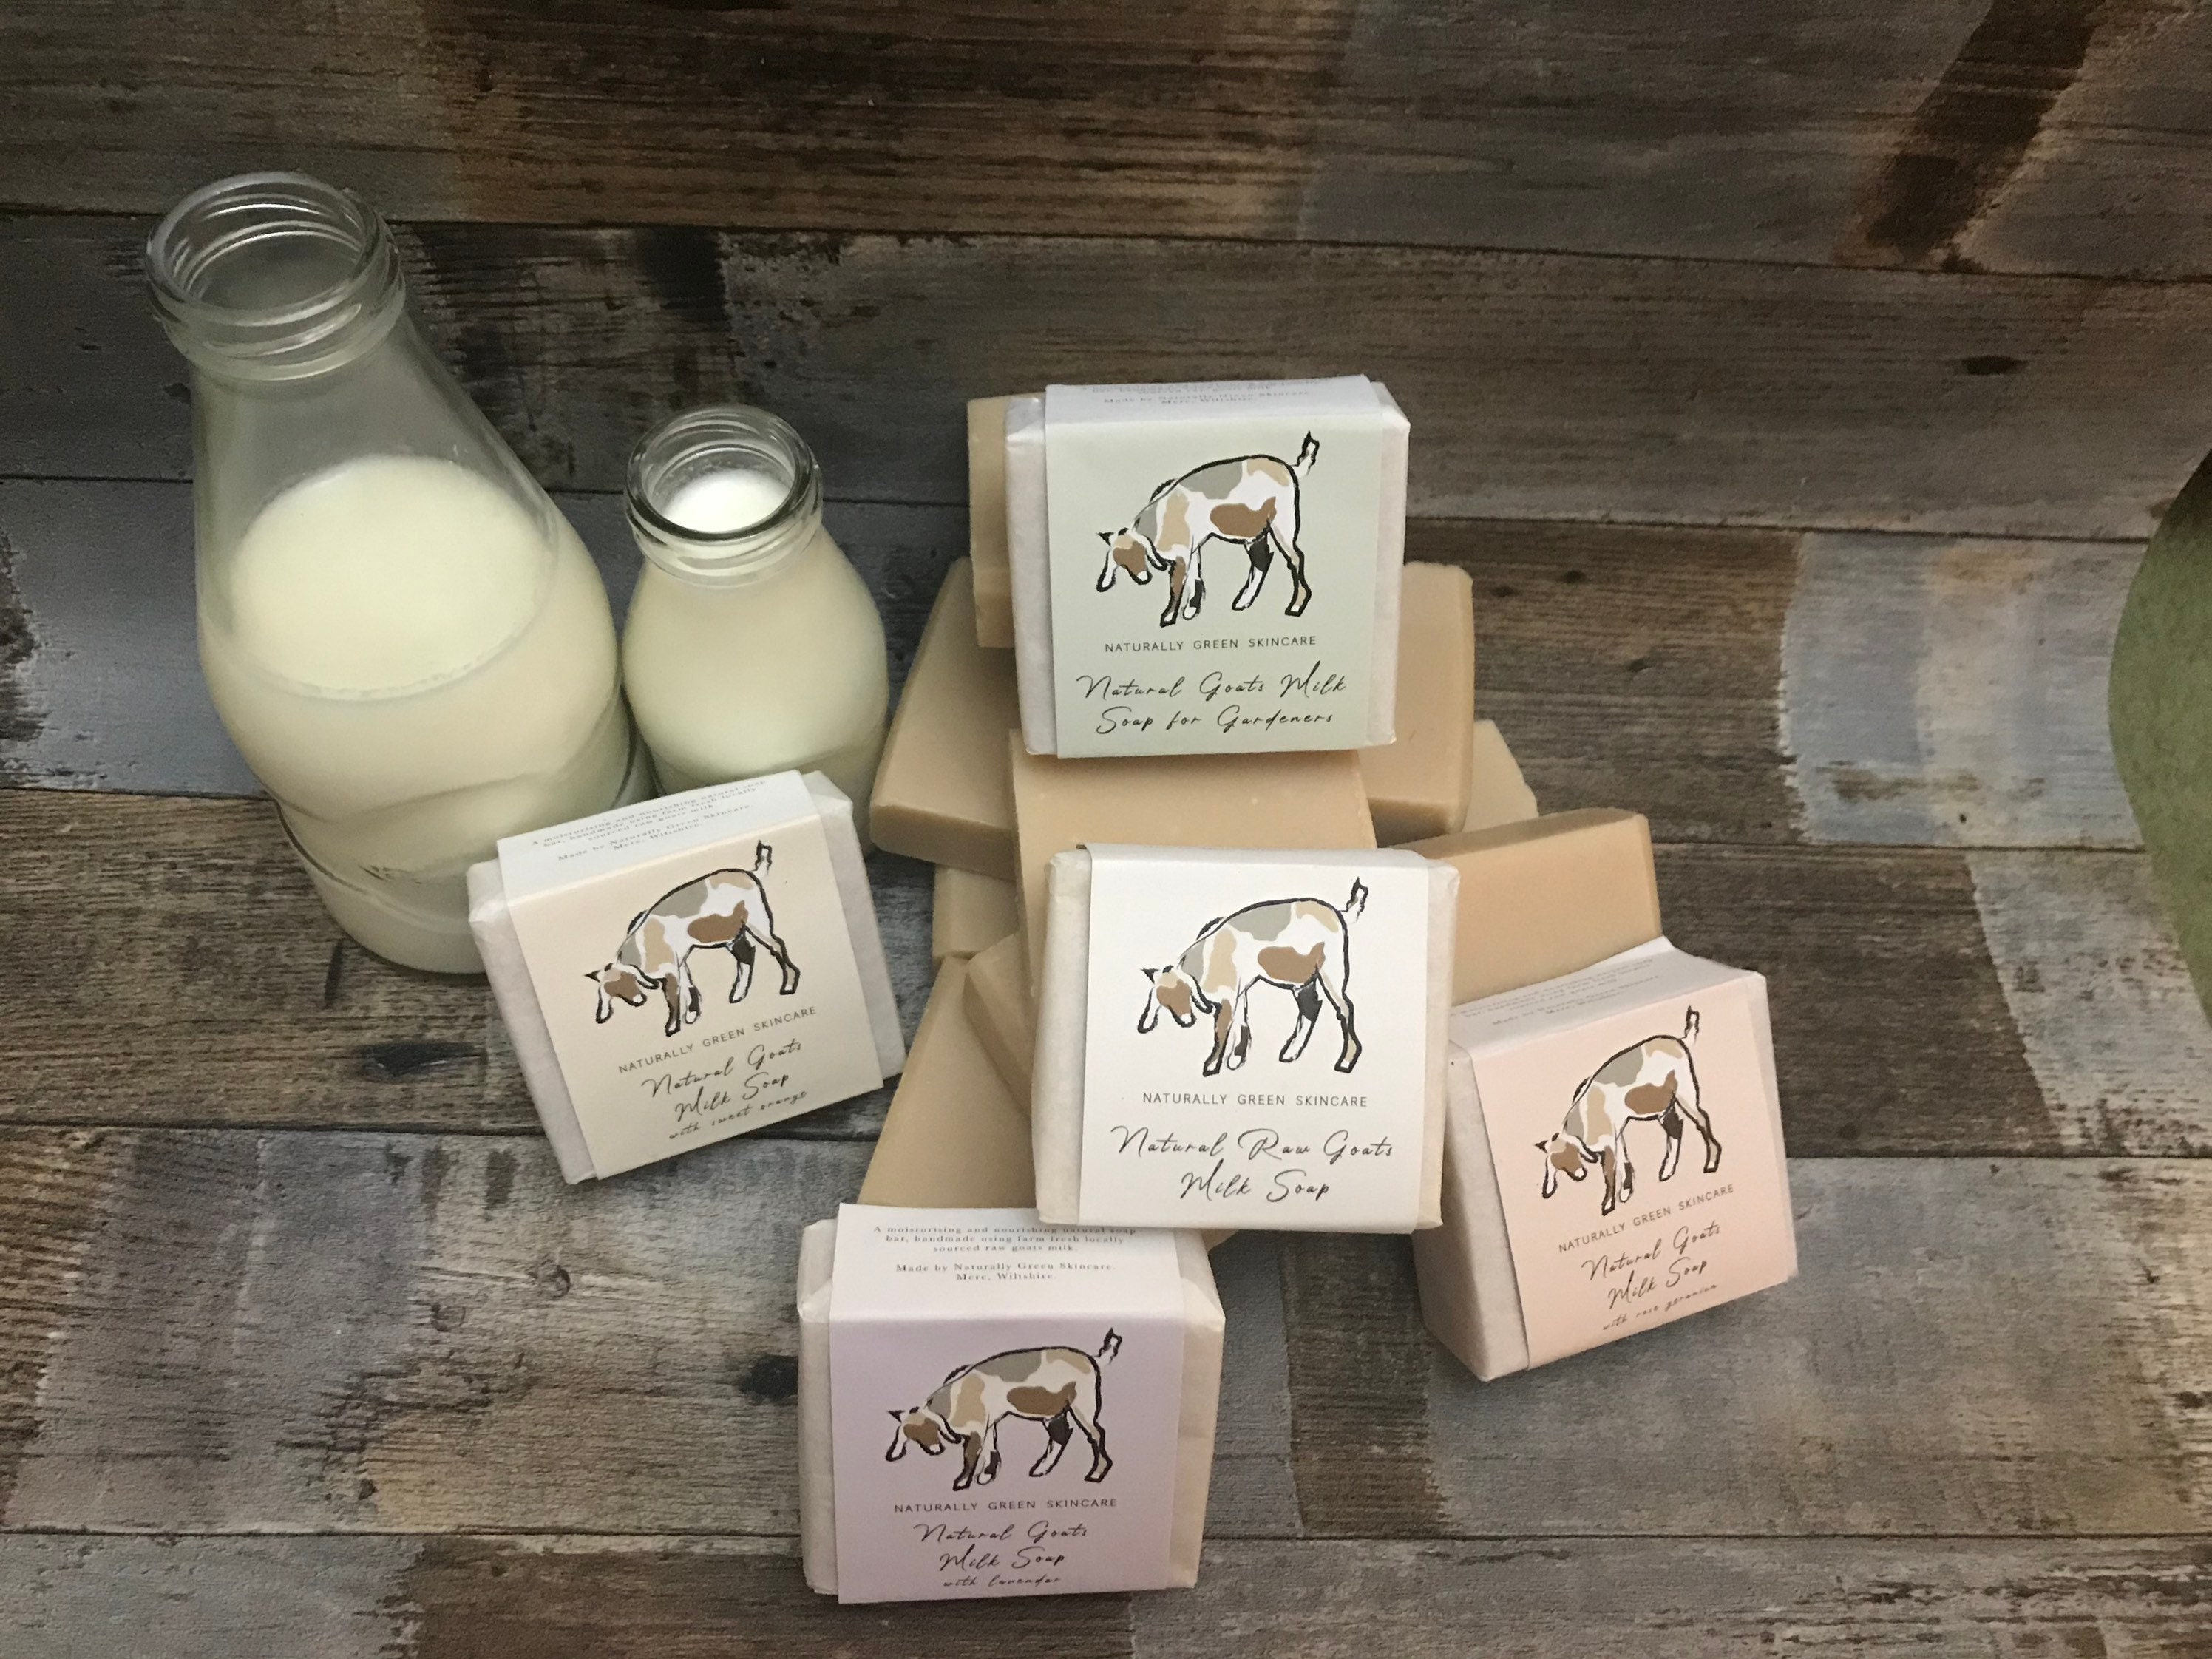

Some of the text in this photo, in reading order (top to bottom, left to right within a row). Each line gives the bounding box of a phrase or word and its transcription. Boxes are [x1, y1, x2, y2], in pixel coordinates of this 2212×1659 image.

[1105, 636, 1316, 652] NATURALLY GREEN SKINCARE
[1076, 660, 1347, 702] Natural Goats Milk
[1096, 705, 1332, 734] Soap for Gardeners
[619, 1006, 817, 1073] NATURALLY GREEN SKINCARE
[641, 1038, 802, 1098] Natural Goats
[675, 1071, 790, 1122] Milk Soap
[1143, 1093, 1367, 1107] NATURALLY GREEN SKINCARE
[669, 1090, 807, 1139] with sweet orange
[1110, 1126, 1392, 1165] Natural Raw Goats
[1180, 1158, 1329, 1202] Milk Soap
[887, 1226, 962, 1234] moisturising
[994, 1227, 1057, 1235] nourishing
[1558, 1184, 1734, 1253] NATURALLY GREEN SKINCARE
[1581, 1220, 1721, 1280] Natural Goats
[934, 1264, 948, 1272] by
[954, 1263, 1011, 1271] Naturally
[1607, 1256, 1707, 1309] Milk Soap
[1603, 1313, 1627, 1330] with
[894, 1498, 1118, 1513] NATURALLY GREEN SKINCARE
[913, 1520, 1088, 1544] Natural Goats
[939, 1544, 1065, 1572] Milk Soap
[943, 1575, 977, 1587] with
